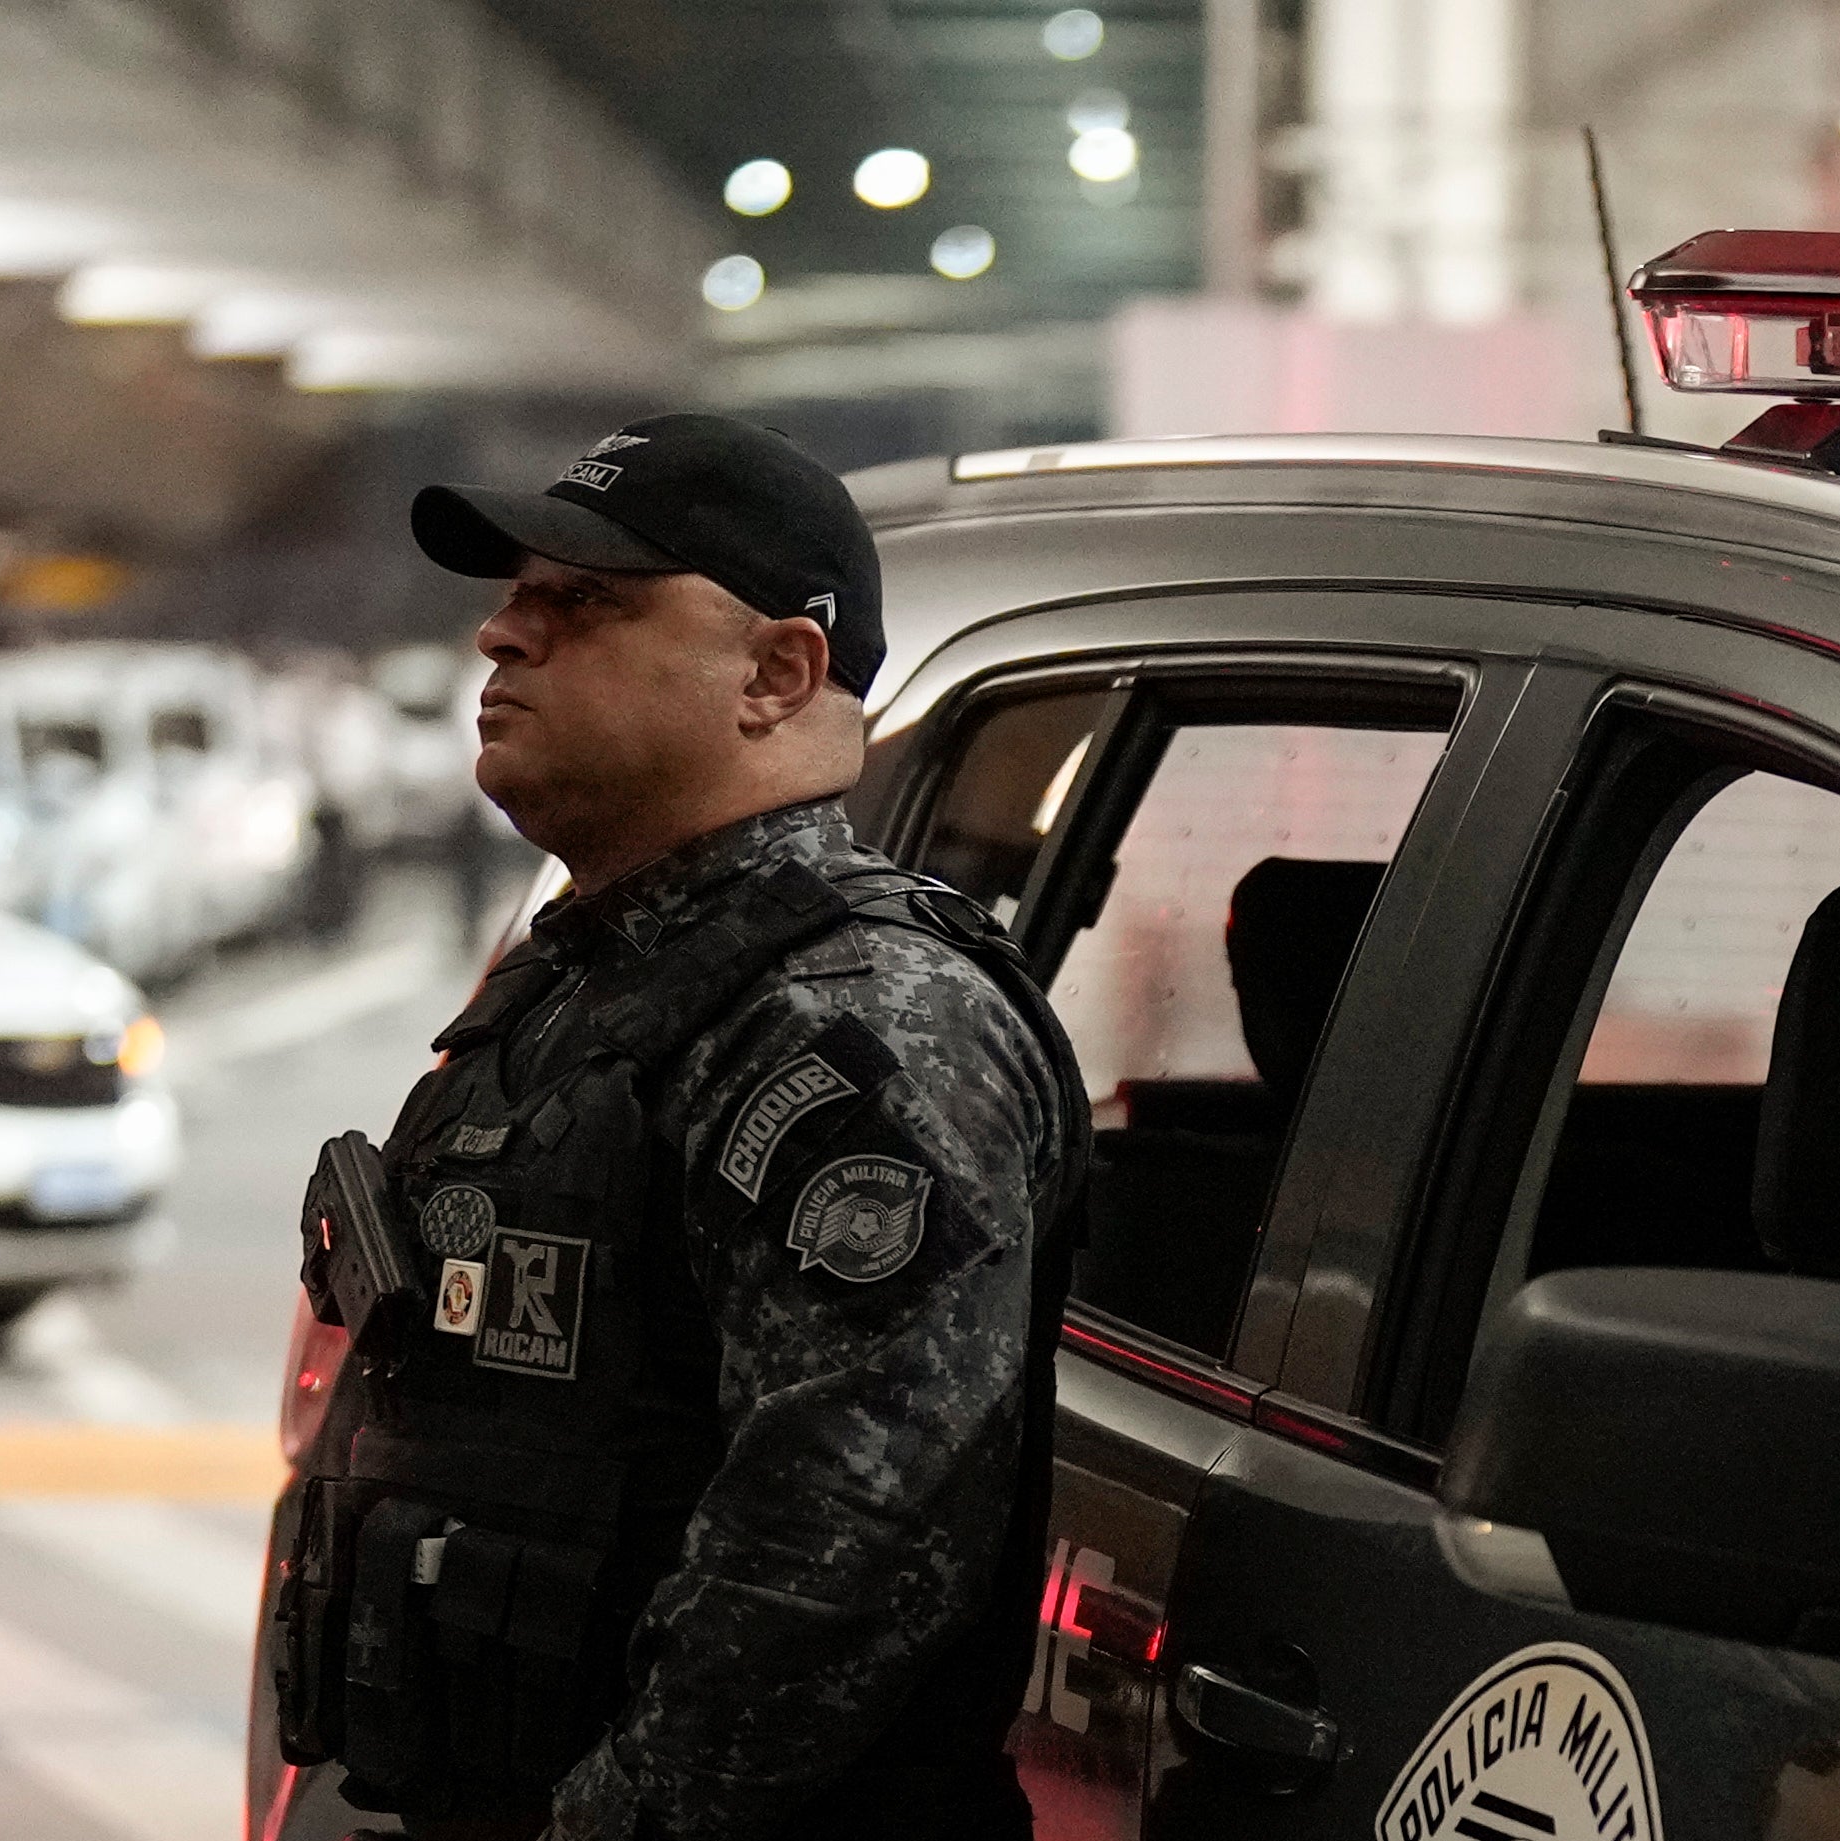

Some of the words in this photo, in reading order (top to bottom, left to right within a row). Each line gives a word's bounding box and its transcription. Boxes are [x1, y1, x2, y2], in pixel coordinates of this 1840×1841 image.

[727, 1064, 838, 1184] CHOQUE
[841, 1165, 909, 1188] MILITAR
[482, 1328, 568, 1368] ROCAM
